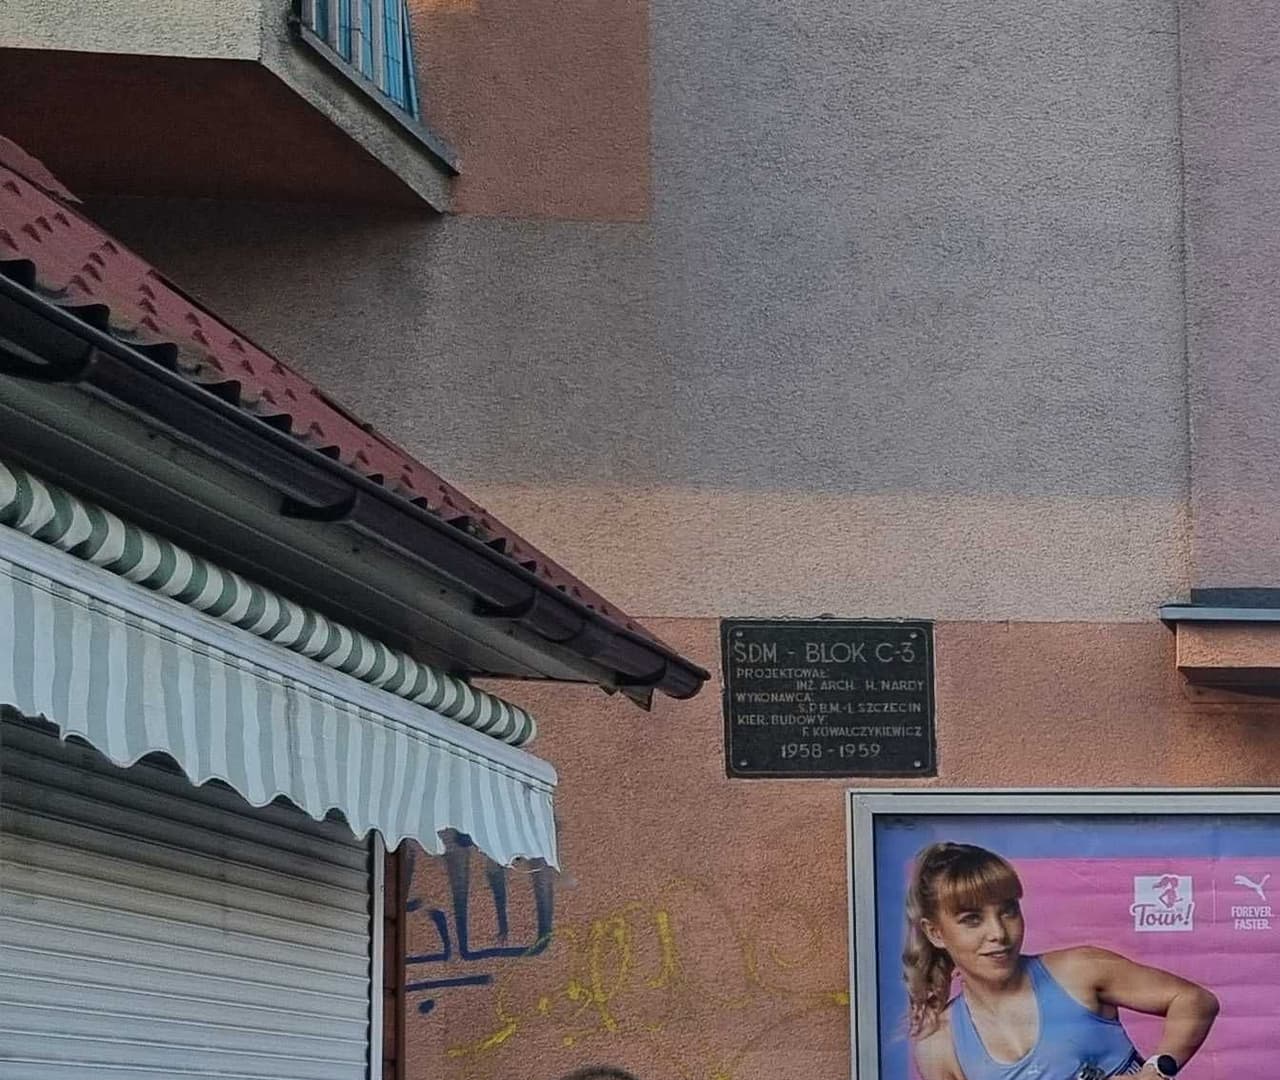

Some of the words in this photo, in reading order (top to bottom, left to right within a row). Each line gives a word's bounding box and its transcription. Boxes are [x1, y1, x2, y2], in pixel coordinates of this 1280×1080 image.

[806, 641, 867, 664] BLOK
[875, 641, 915, 663] C-3
[858, 703, 921, 713] SZCZECIN
[1131, 903, 1194, 927] Tour!
